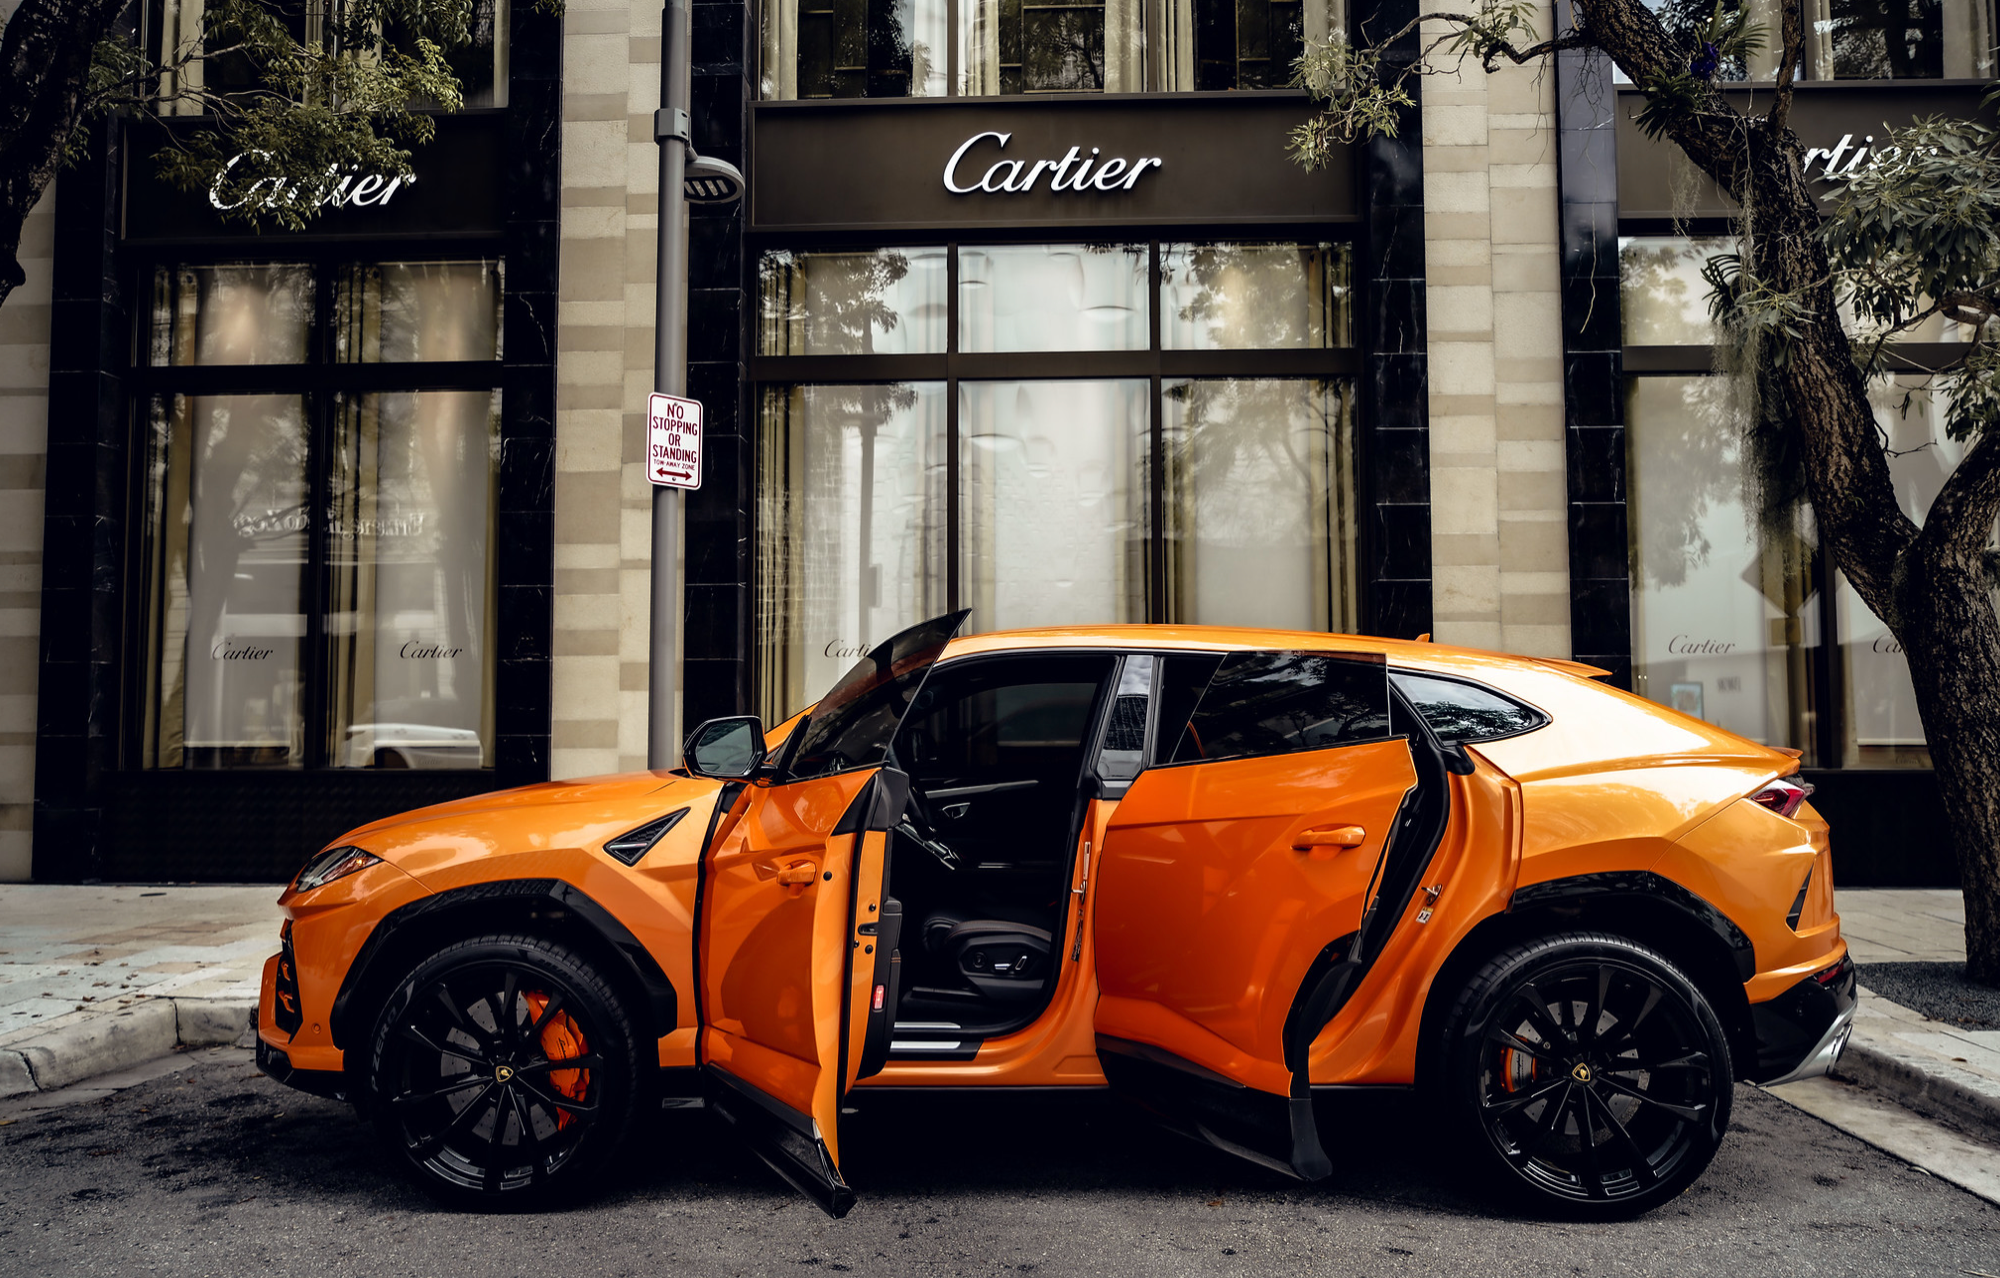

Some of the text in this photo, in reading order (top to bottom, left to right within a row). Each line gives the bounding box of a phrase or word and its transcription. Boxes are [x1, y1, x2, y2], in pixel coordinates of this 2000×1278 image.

[943, 131, 1162, 193] Cartier
[667, 403, 684, 419] NO
[652, 415, 698, 436] STOPPING
[668, 433, 681, 447] OR
[652, 444, 697, 464] STANDING
[681, 463, 695, 471] ZONE
[211, 642, 274, 660] Cartier
[400, 641, 463, 659] Cartier
[824, 639, 871, 658] Carti
[1668, 634, 1735, 654] Cartier
